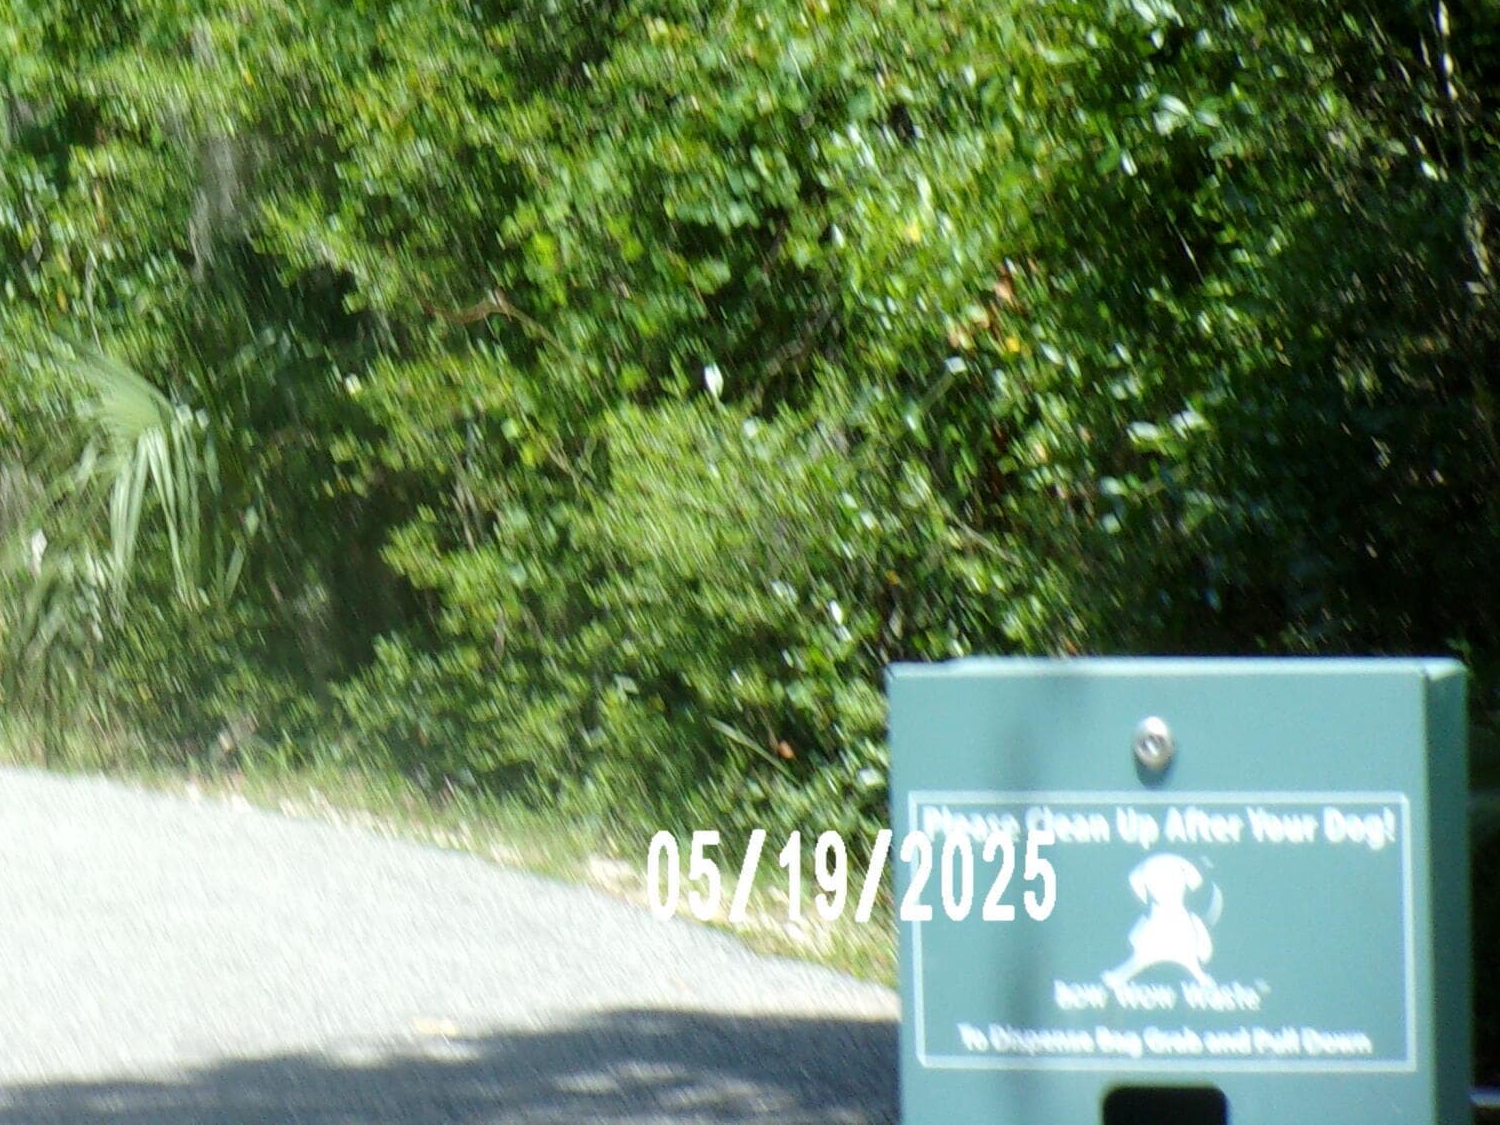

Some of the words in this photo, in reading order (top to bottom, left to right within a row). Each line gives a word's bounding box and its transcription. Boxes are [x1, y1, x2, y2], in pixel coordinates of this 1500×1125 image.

[923, 805, 1022, 843] Please
[1025, 806, 1111, 843] Clean
[1116, 806, 1160, 850] Up
[1165, 806, 1244, 843] After
[1246, 806, 1318, 843] Your
[1323, 806, 1396, 851] Dog!
